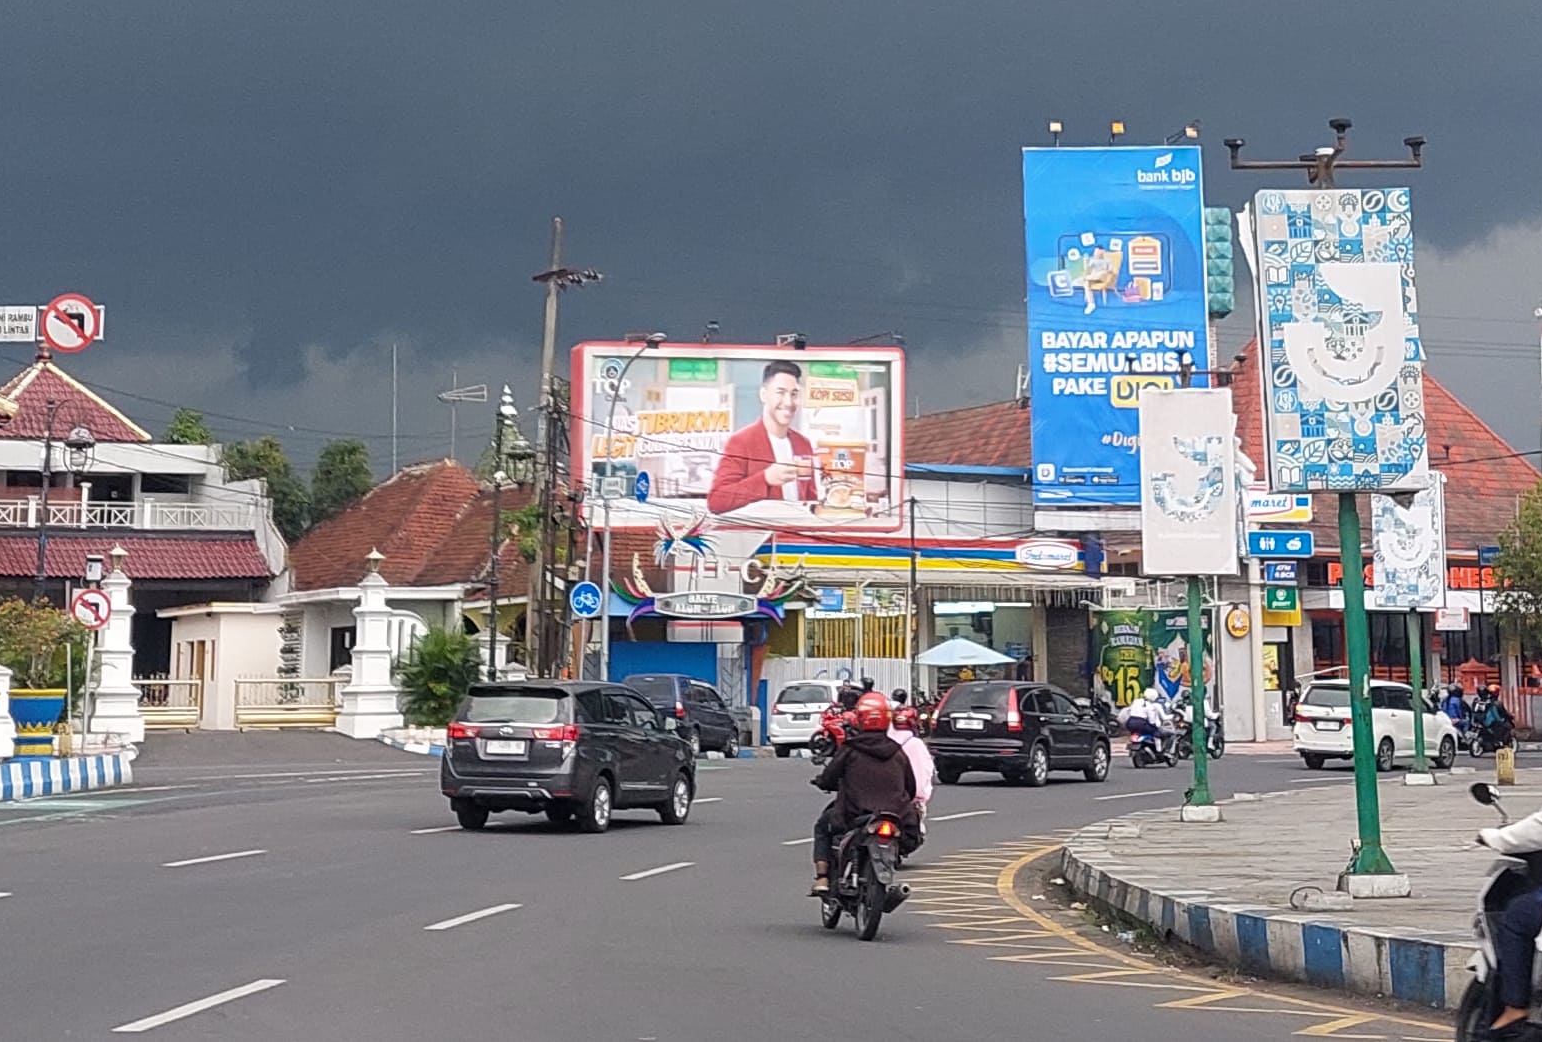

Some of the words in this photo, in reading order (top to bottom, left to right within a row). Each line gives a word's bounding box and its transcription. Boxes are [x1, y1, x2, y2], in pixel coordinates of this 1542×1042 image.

[1137, 169, 1169, 183] bank
[1171, 168, 1196, 184] bjb
[7, 312, 33, 322] RAMBU
[3, 325, 29, 335] LINTAS
[1042, 331, 1108, 349] BAYAR
[1111, 331, 1194, 348] APAPUN
[591, 378, 631, 394] TOP
[1052, 378, 1107, 395] PAKE
[810, 389, 830, 401] KOPI
[688, 594, 719, 605] HALTE
